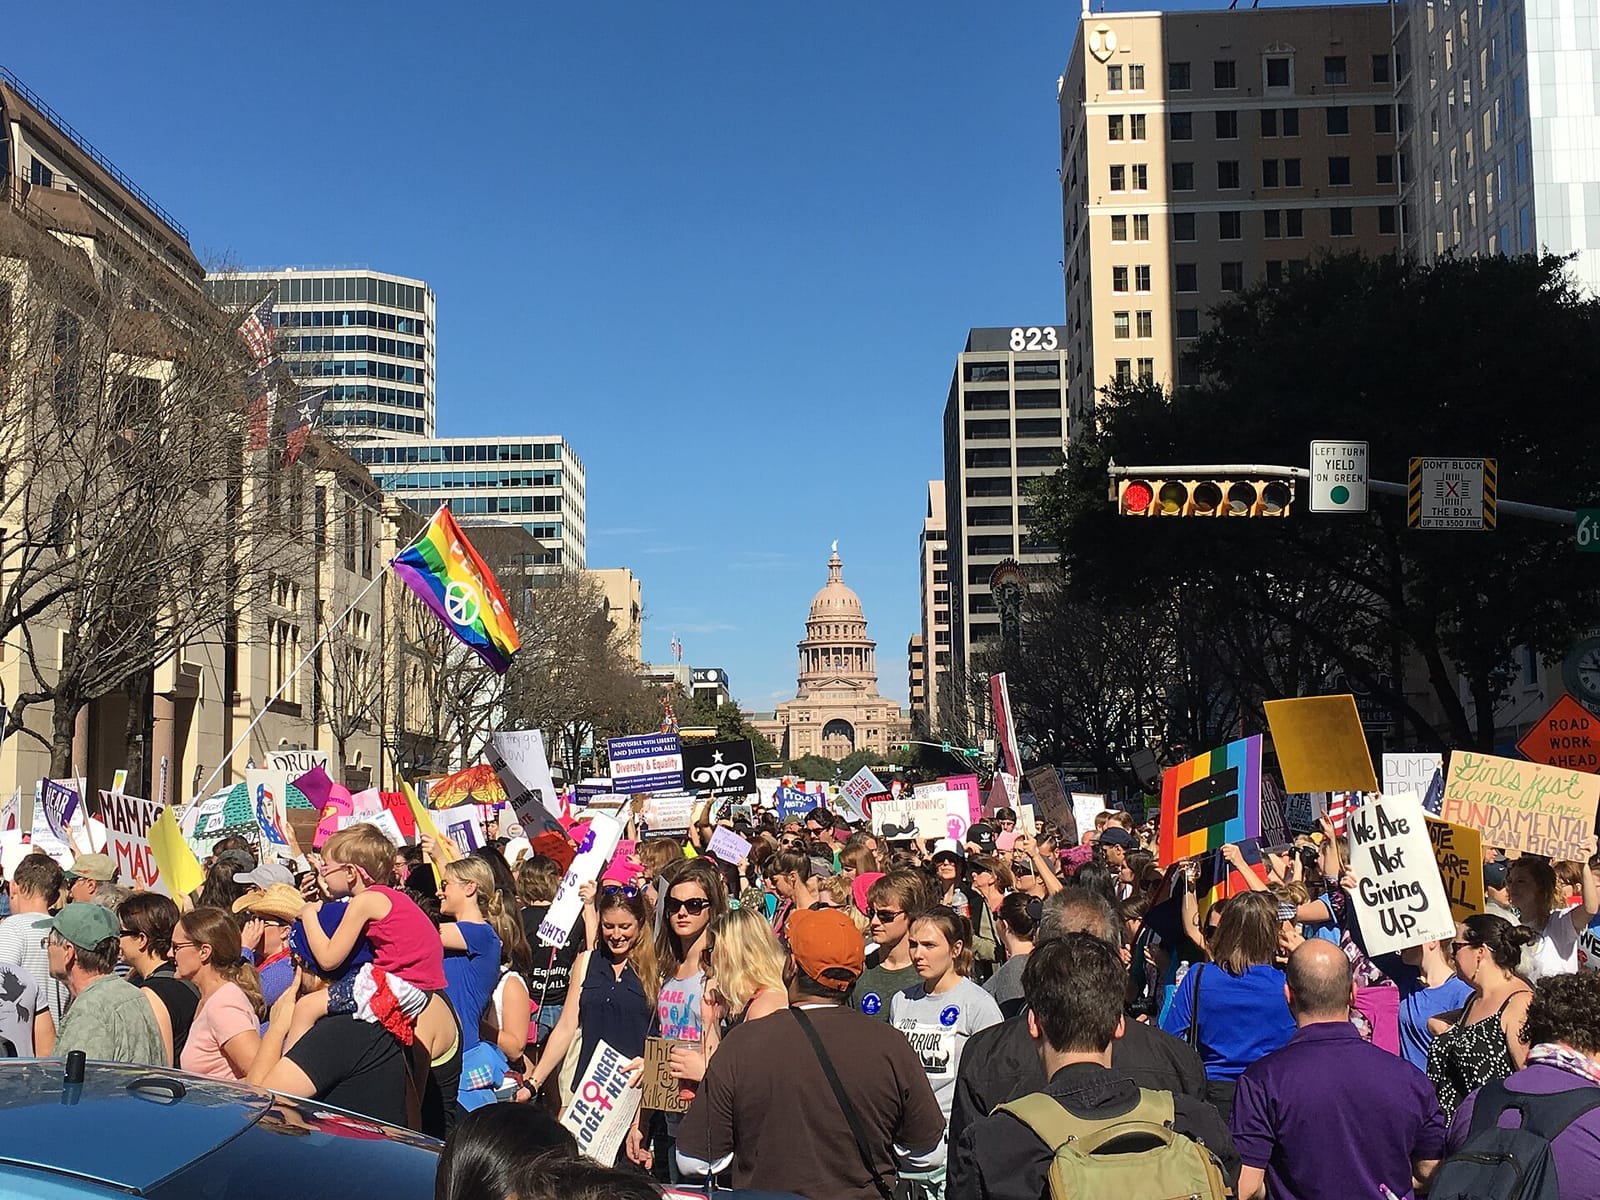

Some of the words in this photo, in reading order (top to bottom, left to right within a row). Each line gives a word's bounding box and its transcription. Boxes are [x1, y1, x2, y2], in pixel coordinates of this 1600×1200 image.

[1009, 327, 1058, 351] 823
[1315, 448, 1336, 456] LEFT
[1342, 448, 1365, 456] TURN
[1326, 460, 1355, 470] YIELD
[1452, 462, 1482, 470] BLOCK
[1317, 474, 1328, 482] ON
[1335, 474, 1363, 482] GREEN
[1432, 508, 1449, 516] THE
[1453, 508, 1473, 516] BOX
[1577, 515, 1600, 546] 6t
[1549, 718, 1590, 732] ROAD
[628, 748, 650, 756] JUSTICE
[1550, 736, 1592, 750] WORK
[273, 754, 328, 772] DRUM
[616, 762, 644, 774] Diversity
[646, 760, 651, 770] &
[652, 757, 678, 770] Equality
[1385, 758, 1436, 778] DUMP
[1549, 754, 1598, 768] AHEAD
[1454, 753, 1522, 791] Girls
[845, 775, 866, 794] STILL
[854, 780, 872, 798] RISE
[953, 782, 970, 791] am
[1519, 772, 1584, 808] just
[46, 786, 70, 814] HEAR
[876, 802, 900, 812] STILL
[905, 798, 945, 812] BURNING
[208, 816, 223, 828] ON
[1351, 810, 1376, 846] We
[1376, 804, 1410, 840] Are
[1444, 799, 1588, 842] FUNDAMENTAL
[1526, 836, 1586, 861] RIGHTS
[115, 839, 160, 887] MAD
[1369, 844, 1406, 876] Not
[1358, 876, 1429, 912] Giving
[1378, 908, 1416, 938] Up
[548, 980, 566, 990] ALL
[899, 1018, 918, 1030] 2016
